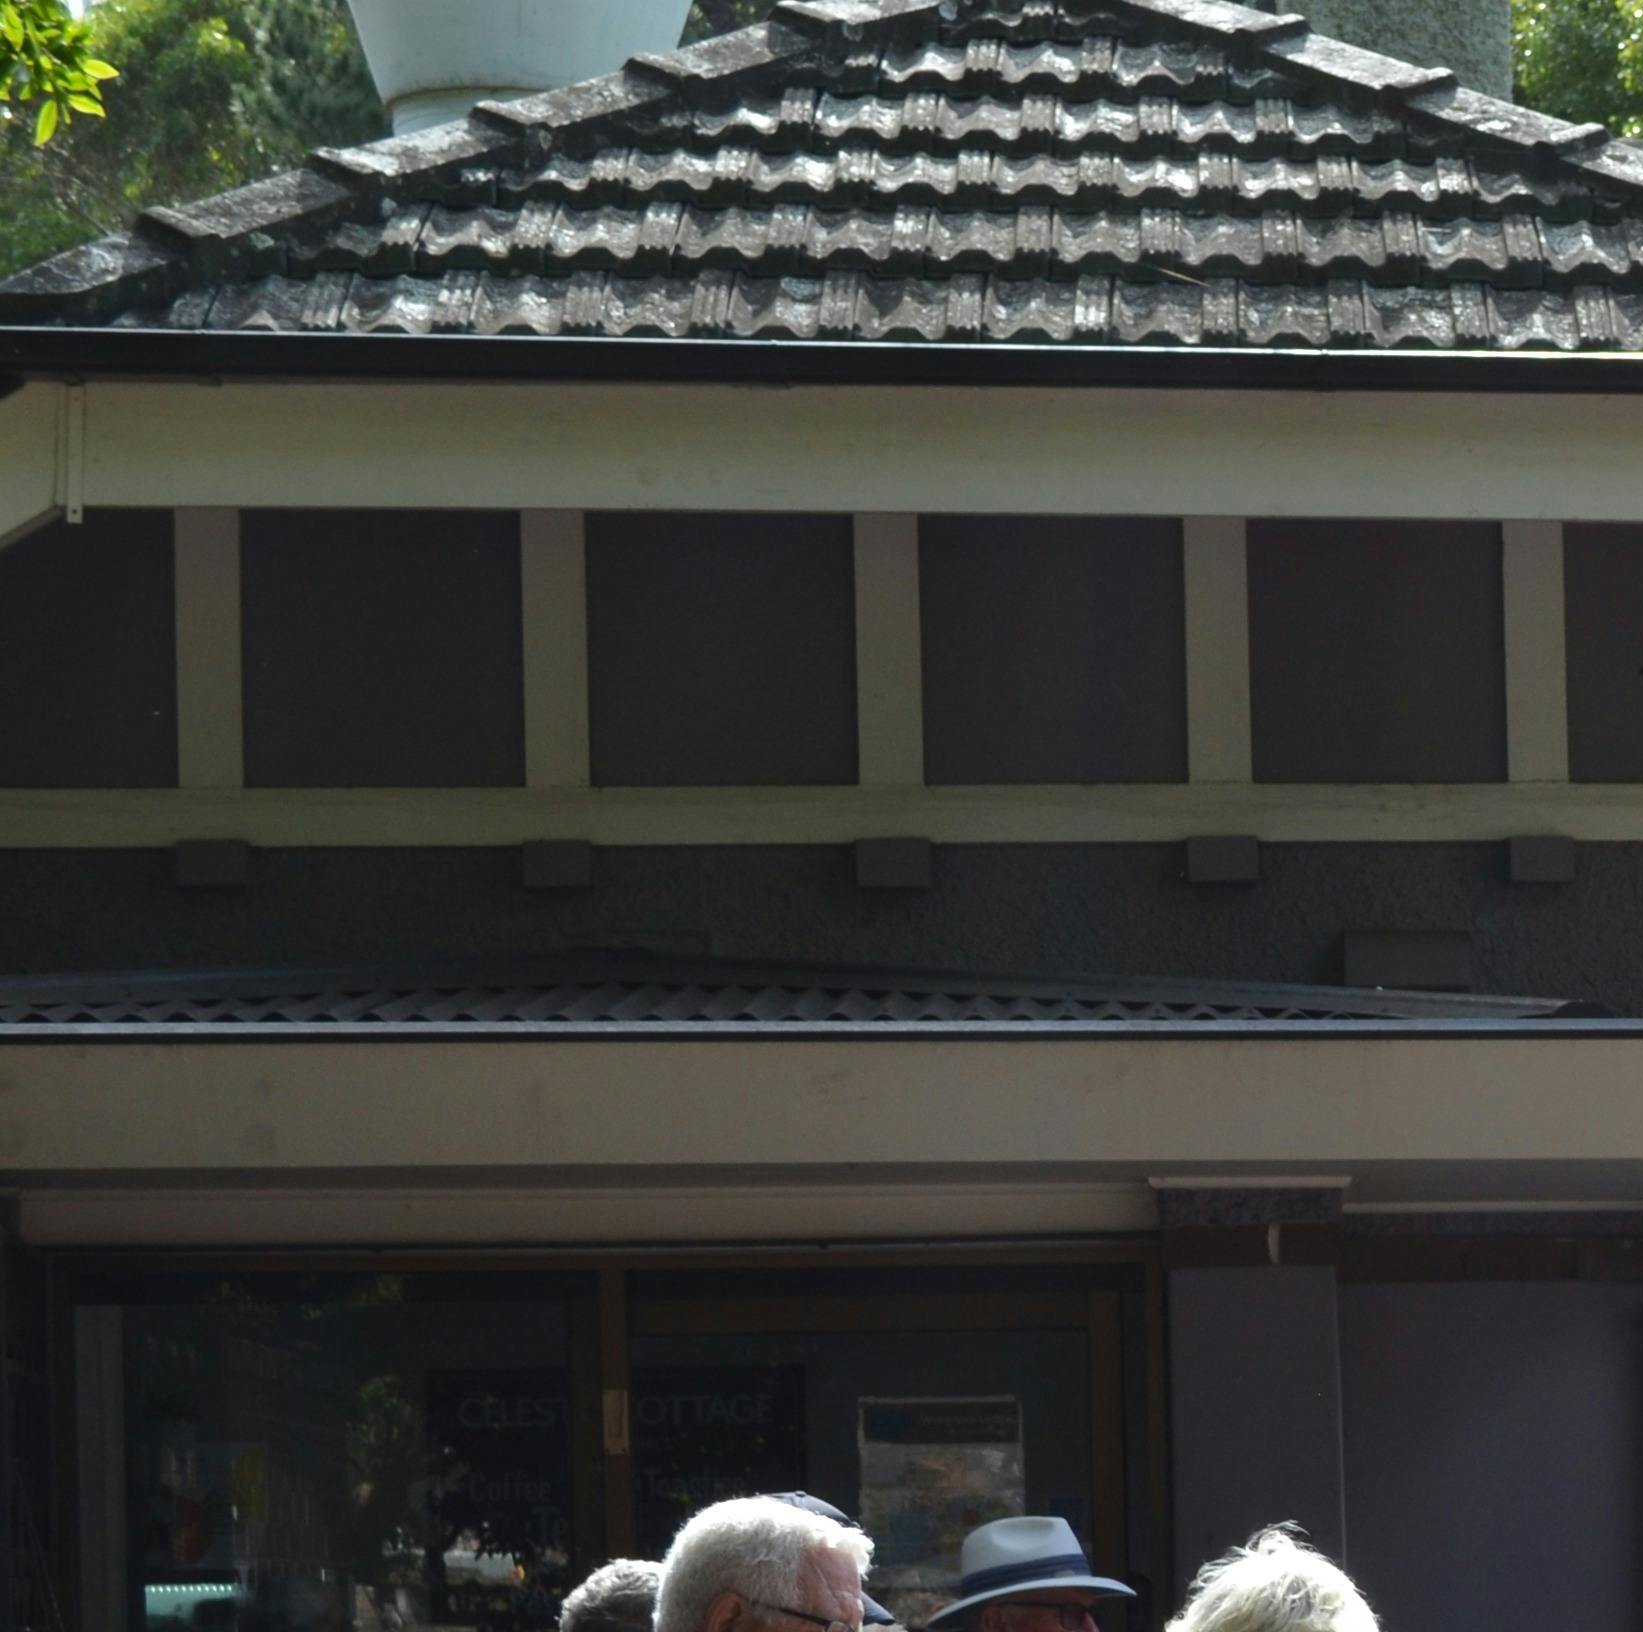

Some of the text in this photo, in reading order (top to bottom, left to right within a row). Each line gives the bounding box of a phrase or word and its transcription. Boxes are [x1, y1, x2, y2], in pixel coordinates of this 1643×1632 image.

[457, 1394, 771, 1427] CELEST OTTAGE
[469, 1471, 551, 1502] Coffee
